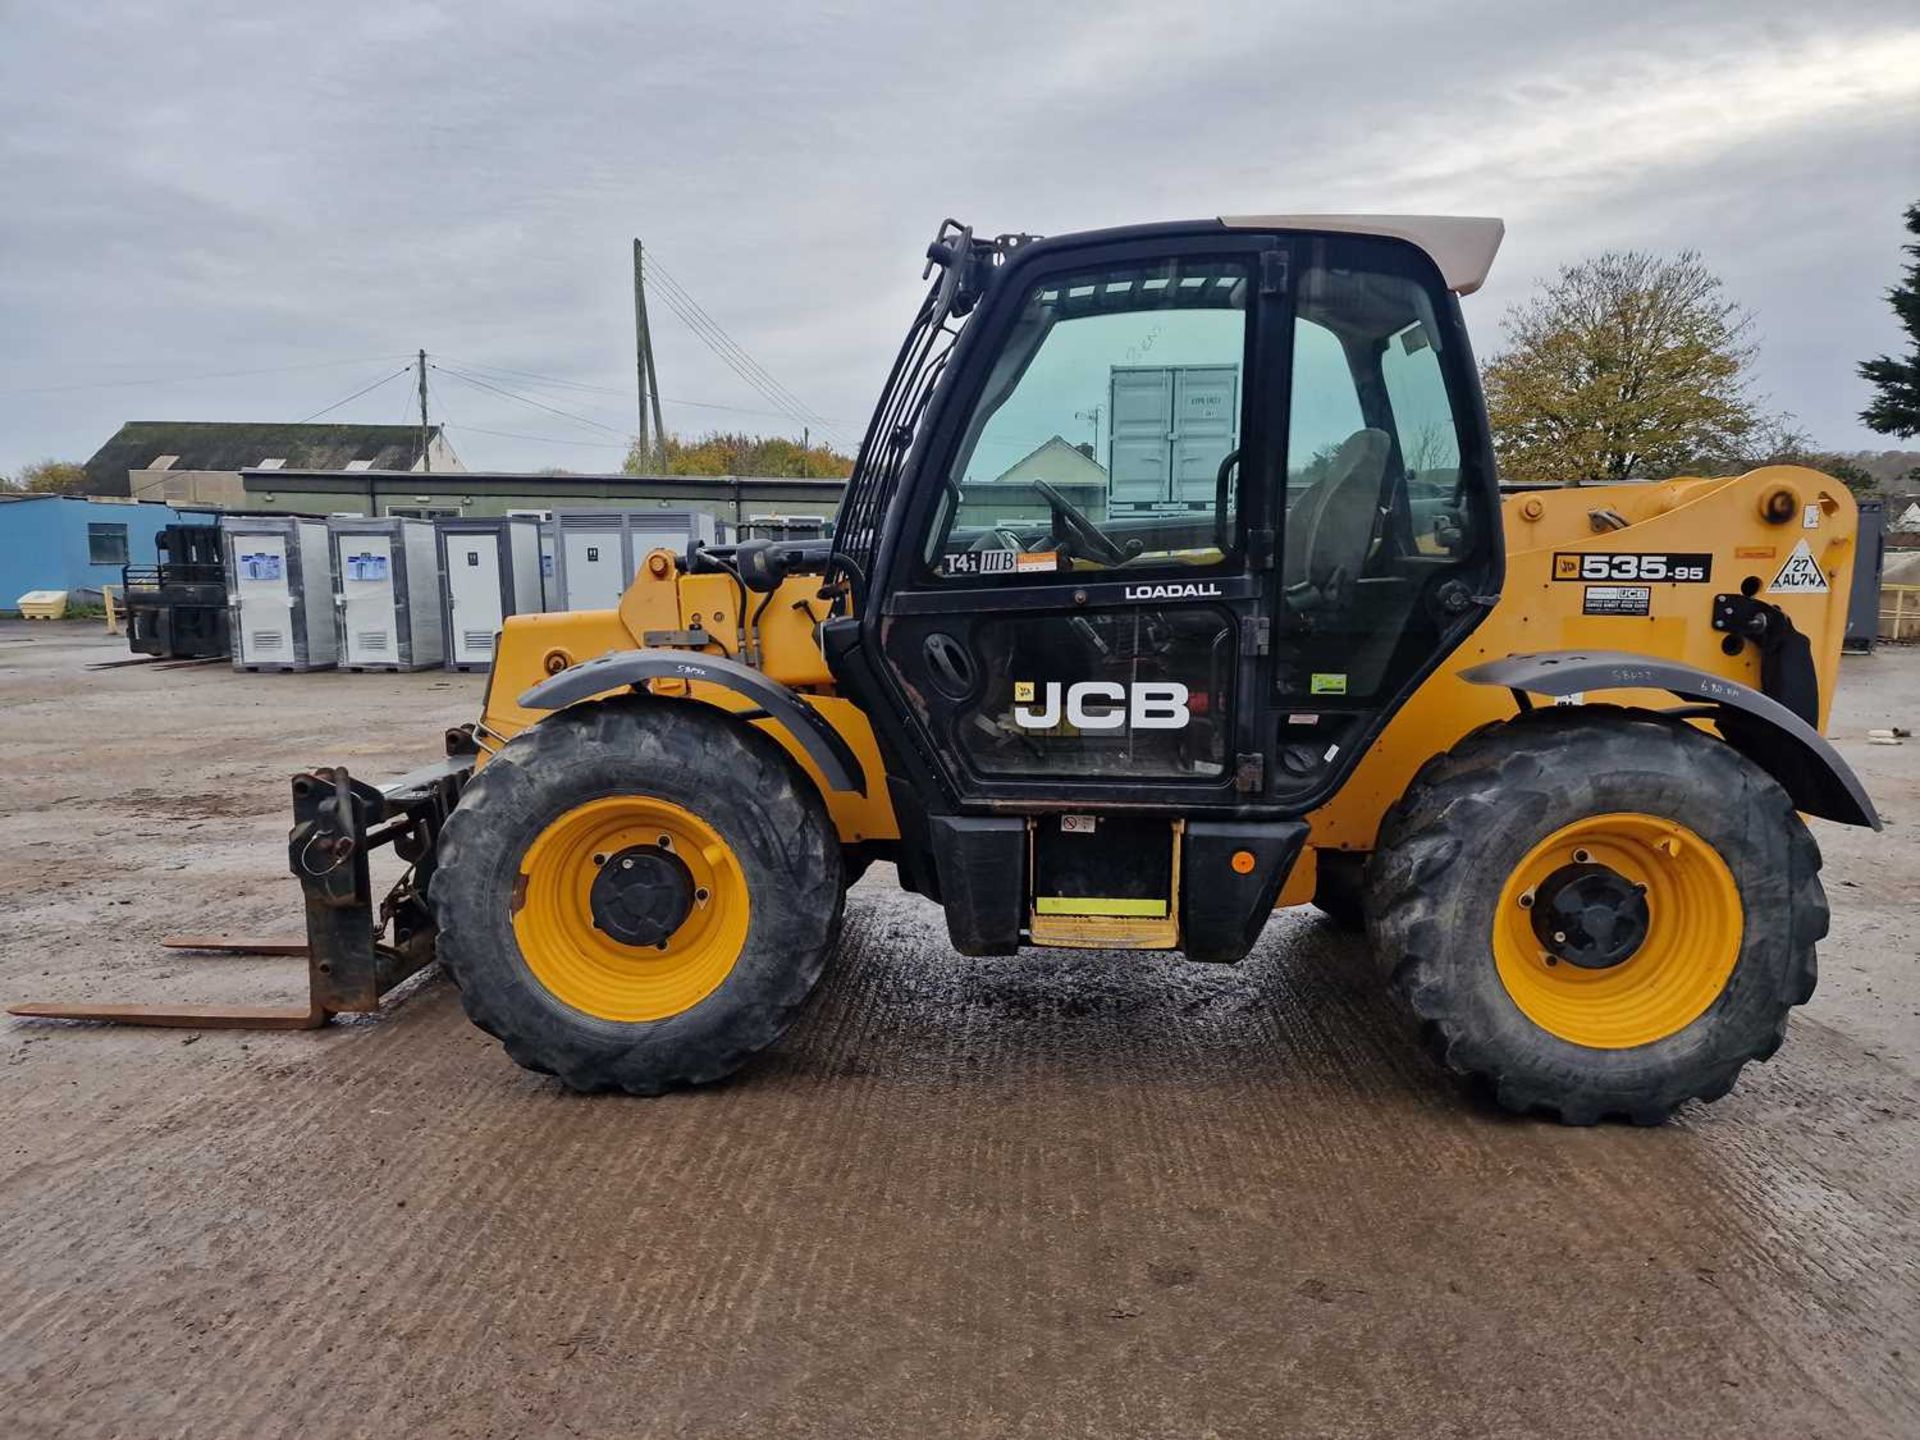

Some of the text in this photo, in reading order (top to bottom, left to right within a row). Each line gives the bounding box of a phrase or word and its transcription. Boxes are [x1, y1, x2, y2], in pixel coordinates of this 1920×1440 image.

[944, 553, 978, 573] T4i
[1582, 555, 1704, 580] 535-95
[1793, 560, 1809, 572] 27
[1125, 583, 1222, 599] LOADALL
[1015, 682, 1190, 728] JCB
